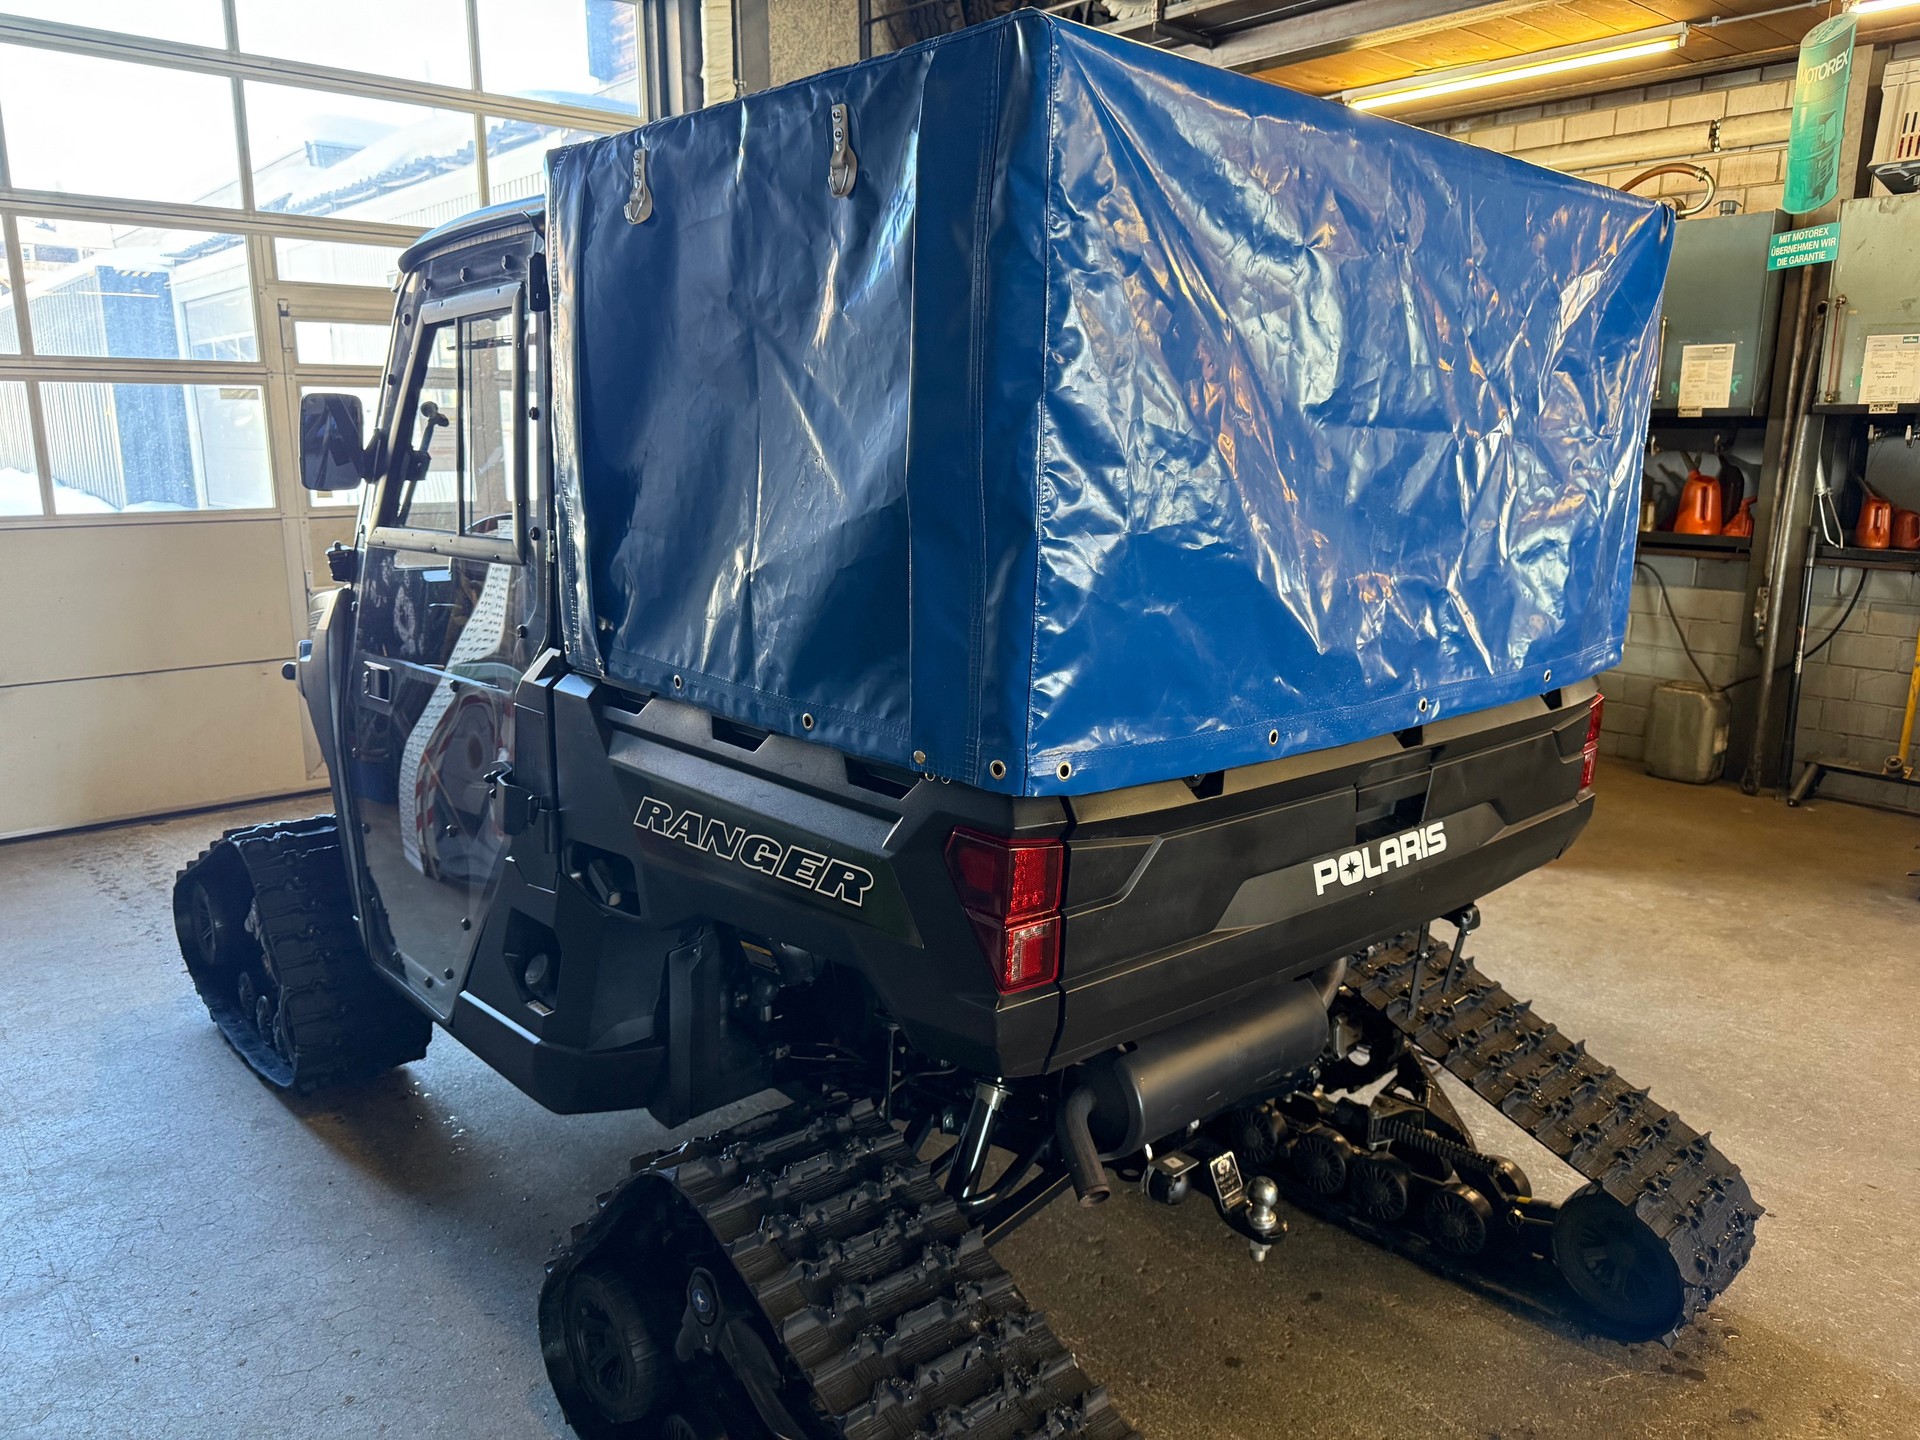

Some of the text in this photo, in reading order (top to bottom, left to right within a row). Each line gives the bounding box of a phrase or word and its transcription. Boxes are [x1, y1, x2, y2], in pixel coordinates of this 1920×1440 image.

[1800, 48, 1849, 85] MOTOREX
[1771, 237, 1836, 256] ÜBERNEHMEN WIR
[1779, 227, 1829, 244] MIT MOTOREX
[1777, 251, 1826, 266] DIE GARANTIE
[633, 796, 874, 907] RANGER
[1313, 821, 1447, 896] POLARIS
